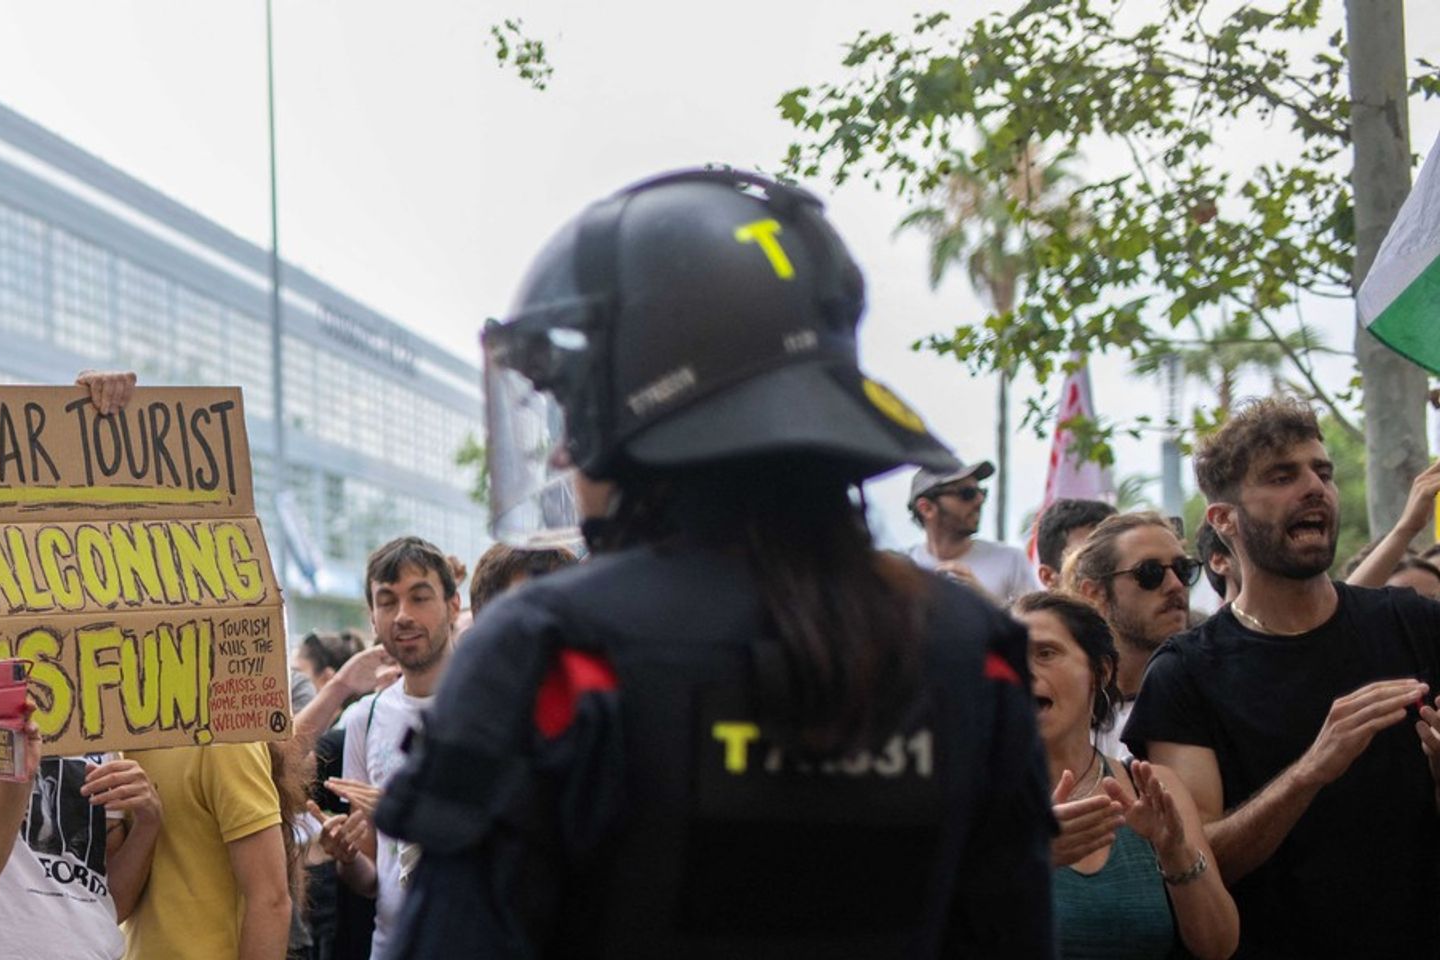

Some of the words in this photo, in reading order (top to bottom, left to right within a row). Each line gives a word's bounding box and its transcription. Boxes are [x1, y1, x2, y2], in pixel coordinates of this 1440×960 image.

[734, 218, 796, 280] T
[65, 397, 237, 496] TOURIST
[219, 617, 271, 638] TOURISM
[253, 638, 274, 653] THE
[228, 657, 265, 676] CITY!!
[75, 617, 215, 746] FUN!
[212, 678, 257, 696] TOURISTS
[262, 676, 277, 691] GO
[241, 690, 285, 709] REFUGEES
[213, 710, 269, 732] WELCOME!
